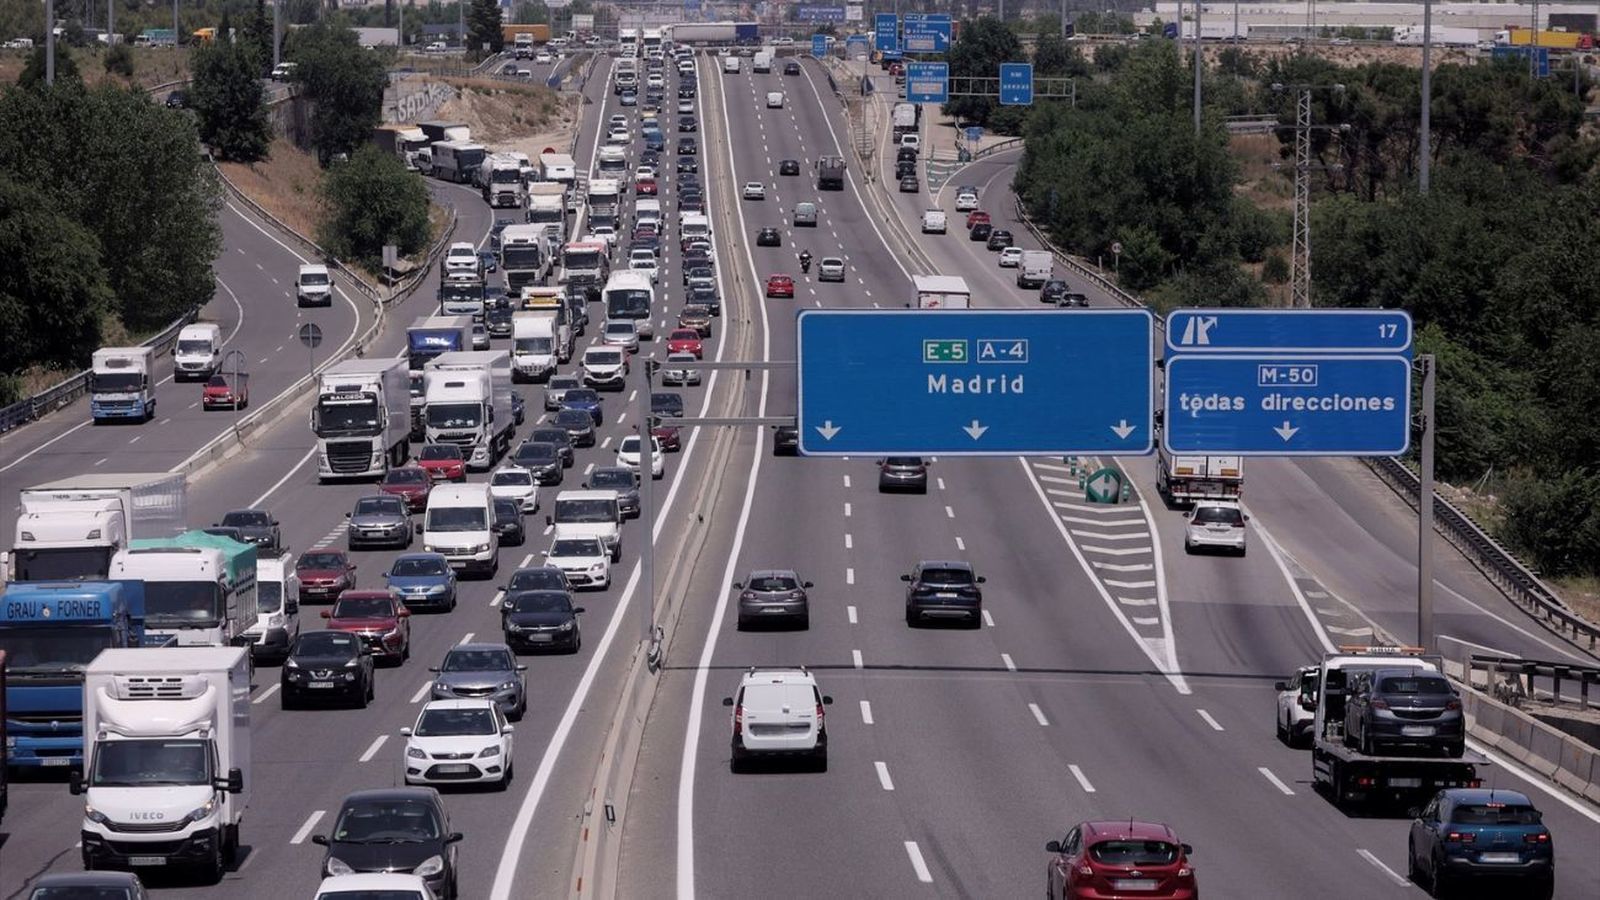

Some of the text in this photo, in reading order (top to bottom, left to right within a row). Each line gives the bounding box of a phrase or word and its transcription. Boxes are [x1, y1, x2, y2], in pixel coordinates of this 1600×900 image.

[1378, 324, 1398, 339] 17
[926, 342, 1024, 360] E-5 A-4
[927, 373, 1024, 394] Madrid
[1260, 368, 1314, 383] M-50
[1260, 393, 1396, 412] direcciones
[6, 600, 101, 619] GRAU FORNER
[129, 811, 164, 820] IVECO
